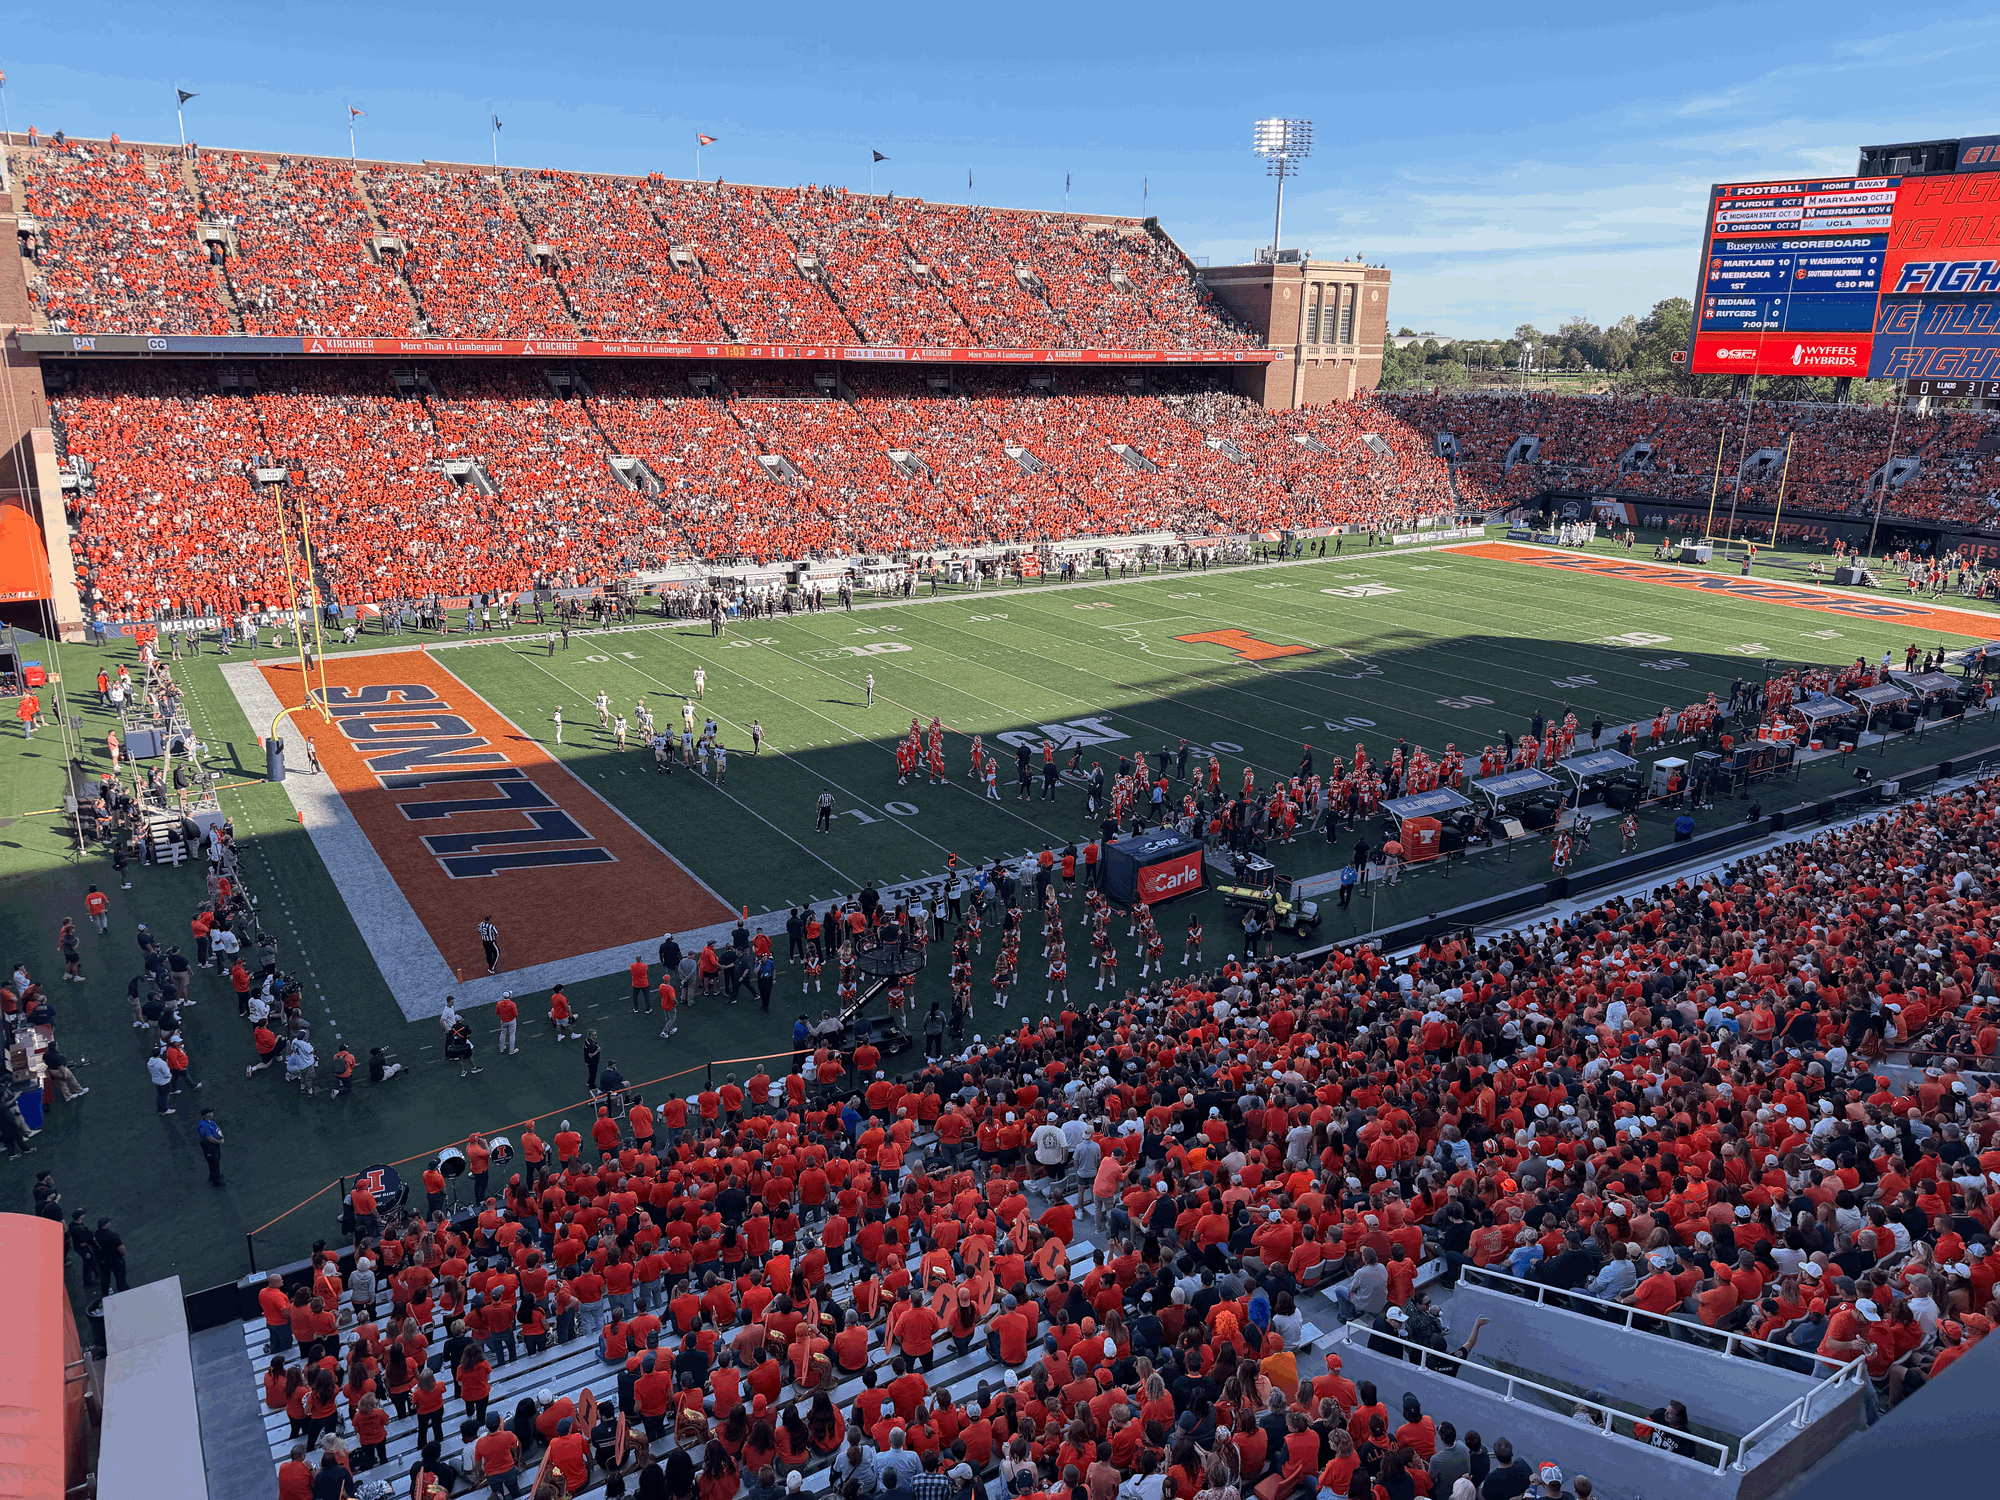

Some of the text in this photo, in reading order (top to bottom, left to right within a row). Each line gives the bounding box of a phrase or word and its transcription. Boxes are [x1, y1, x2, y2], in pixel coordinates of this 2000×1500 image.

[1822, 180, 1885, 190] HOME AWAY
[1737, 185, 1802, 196] FOOTBALL
[1818, 195, 1868, 204] MARYLAND
[1730, 212, 1757, 220] MICHIGAN
[1816, 207, 1866, 215] NEBRASKA
[1782, 238, 1871, 248] SCOREBOARD
[1724, 258, 1790, 267] MARYLAND 10
[1810, 256, 1877, 265] WASHINGTON 0
[1722, 270, 1784, 279] NEBRASKA 7
[1858, 280, 1874, 288] PM
[1718, 298, 1756, 306] INDIANA
[72, 338, 96, 350] CAT
[150, 340, 166, 349] CC
[327, 340, 374, 348] KIRCHNER
[401, 342, 502, 352] More Than A Lumberyard
[537, 342, 578, 350] KIRCHNER
[603, 344, 620, 353] More
[623, 345, 641, 354] Than
[650, 346, 692, 355] Lumberyard
[725, 346, 746, 356] 1:03
[750, 348, 762, 356] :27
[873, 350, 886, 358] BALL
[1804, 346, 1857, 355] WYFFELS
[1002, 352, 1034, 360] Lumberyard
[1128, 352, 1156, 360] Lumberyard
[1673, 352, 1686, 361] 27
[1804, 357, 1855, 365] HYBRIDS
[1920, 382, 1929, 394] 0
[1968, 382, 1975, 392] 3
[1991, 382, 1998, 392] 2
[1958, 543, 1998, 559] GIES
[1521, 555, 1935, 616] ILLINOIS
[1640, 658, 1690, 671] 30
[1550, 676, 1598, 688] 40
[1437, 695, 1496, 710] 50
[1324, 716, 1377, 732] 40
[996, 717, 1133, 754] CAT
[312, 683, 619, 880] ILLINOIS
[1397, 794, 1450, 812] ILLINOIS
[840, 800, 920, 826] 10
[949, 854, 956, 866] 2
[1155, 865, 1198, 892] Carle
[366, 1169, 385, 1193] I
